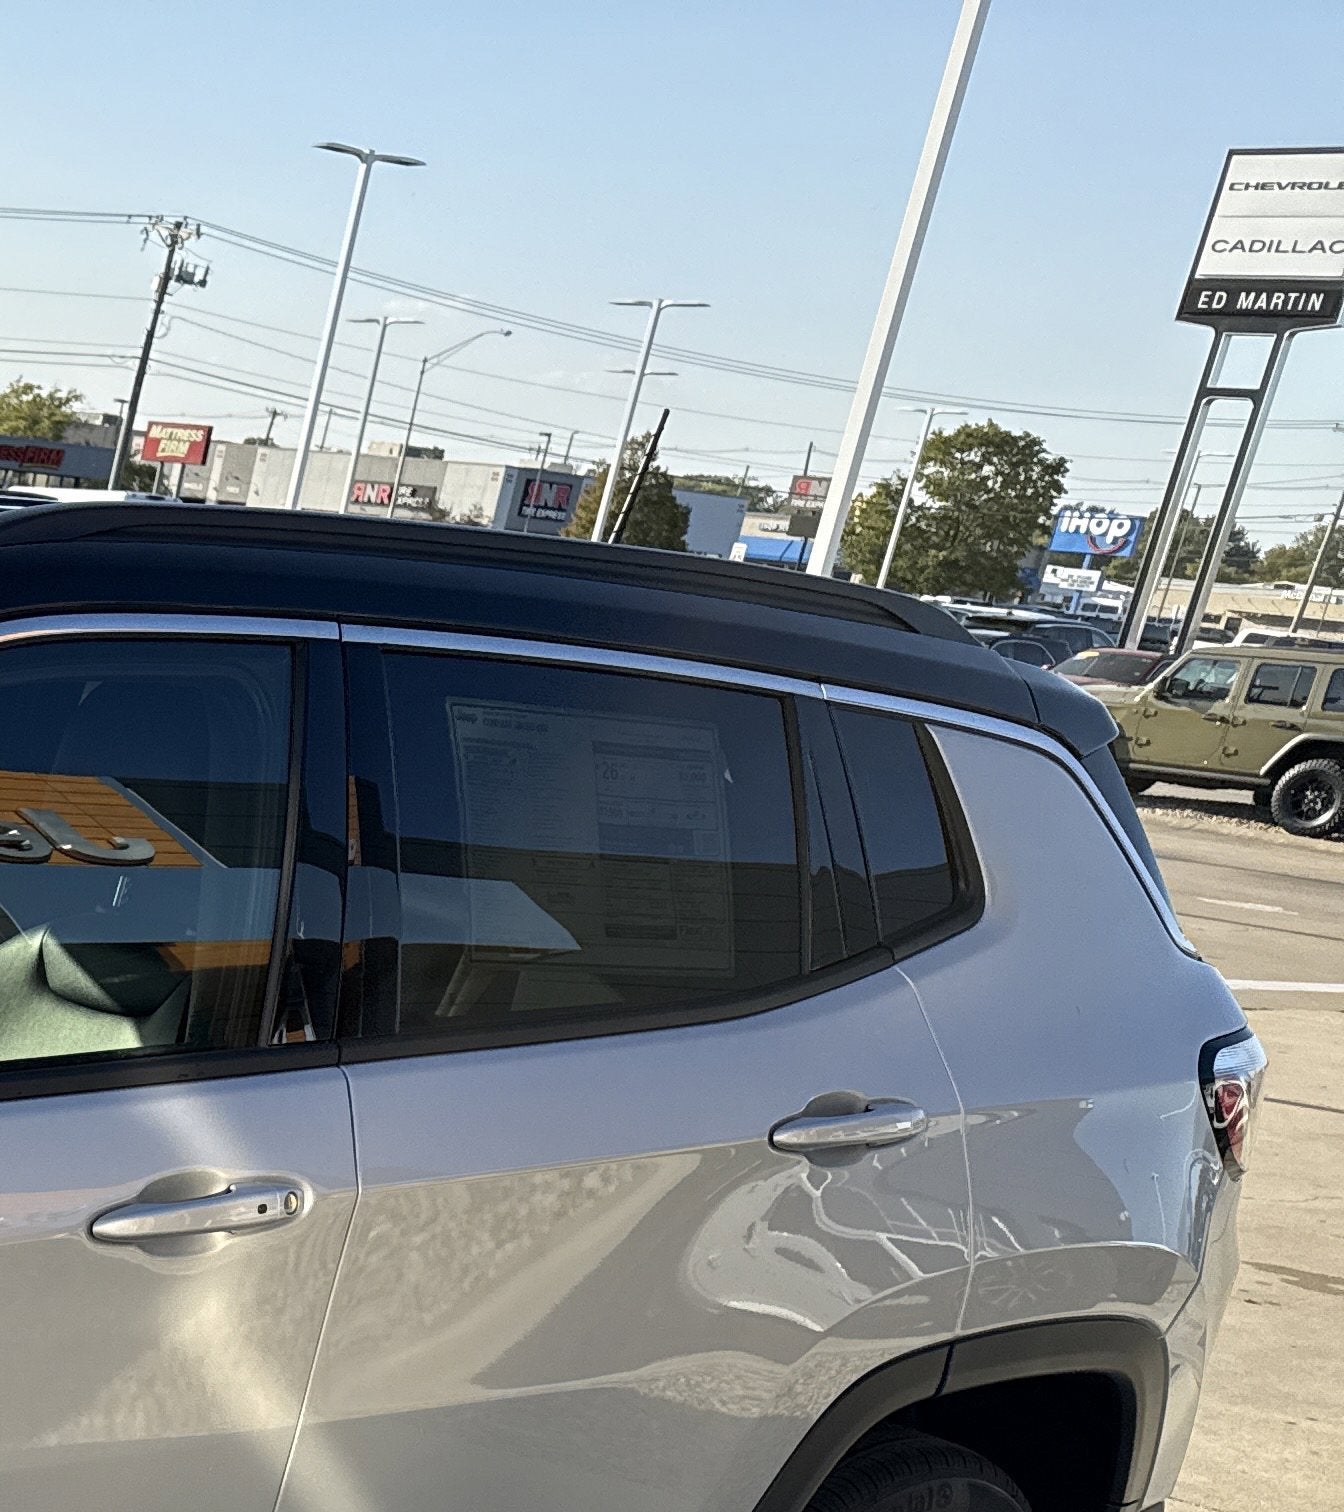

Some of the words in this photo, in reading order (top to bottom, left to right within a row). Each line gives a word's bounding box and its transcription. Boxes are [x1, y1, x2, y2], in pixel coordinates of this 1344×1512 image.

[1228, 181, 1344, 192] CHEVROLE
[1212, 239, 1344, 254] CADILLAC
[1197, 290, 1228, 309] ED
[1236, 291, 1325, 312] MARTIN
[149, 424, 206, 443] MATTRESS
[158, 440, 191, 458] FIRM
